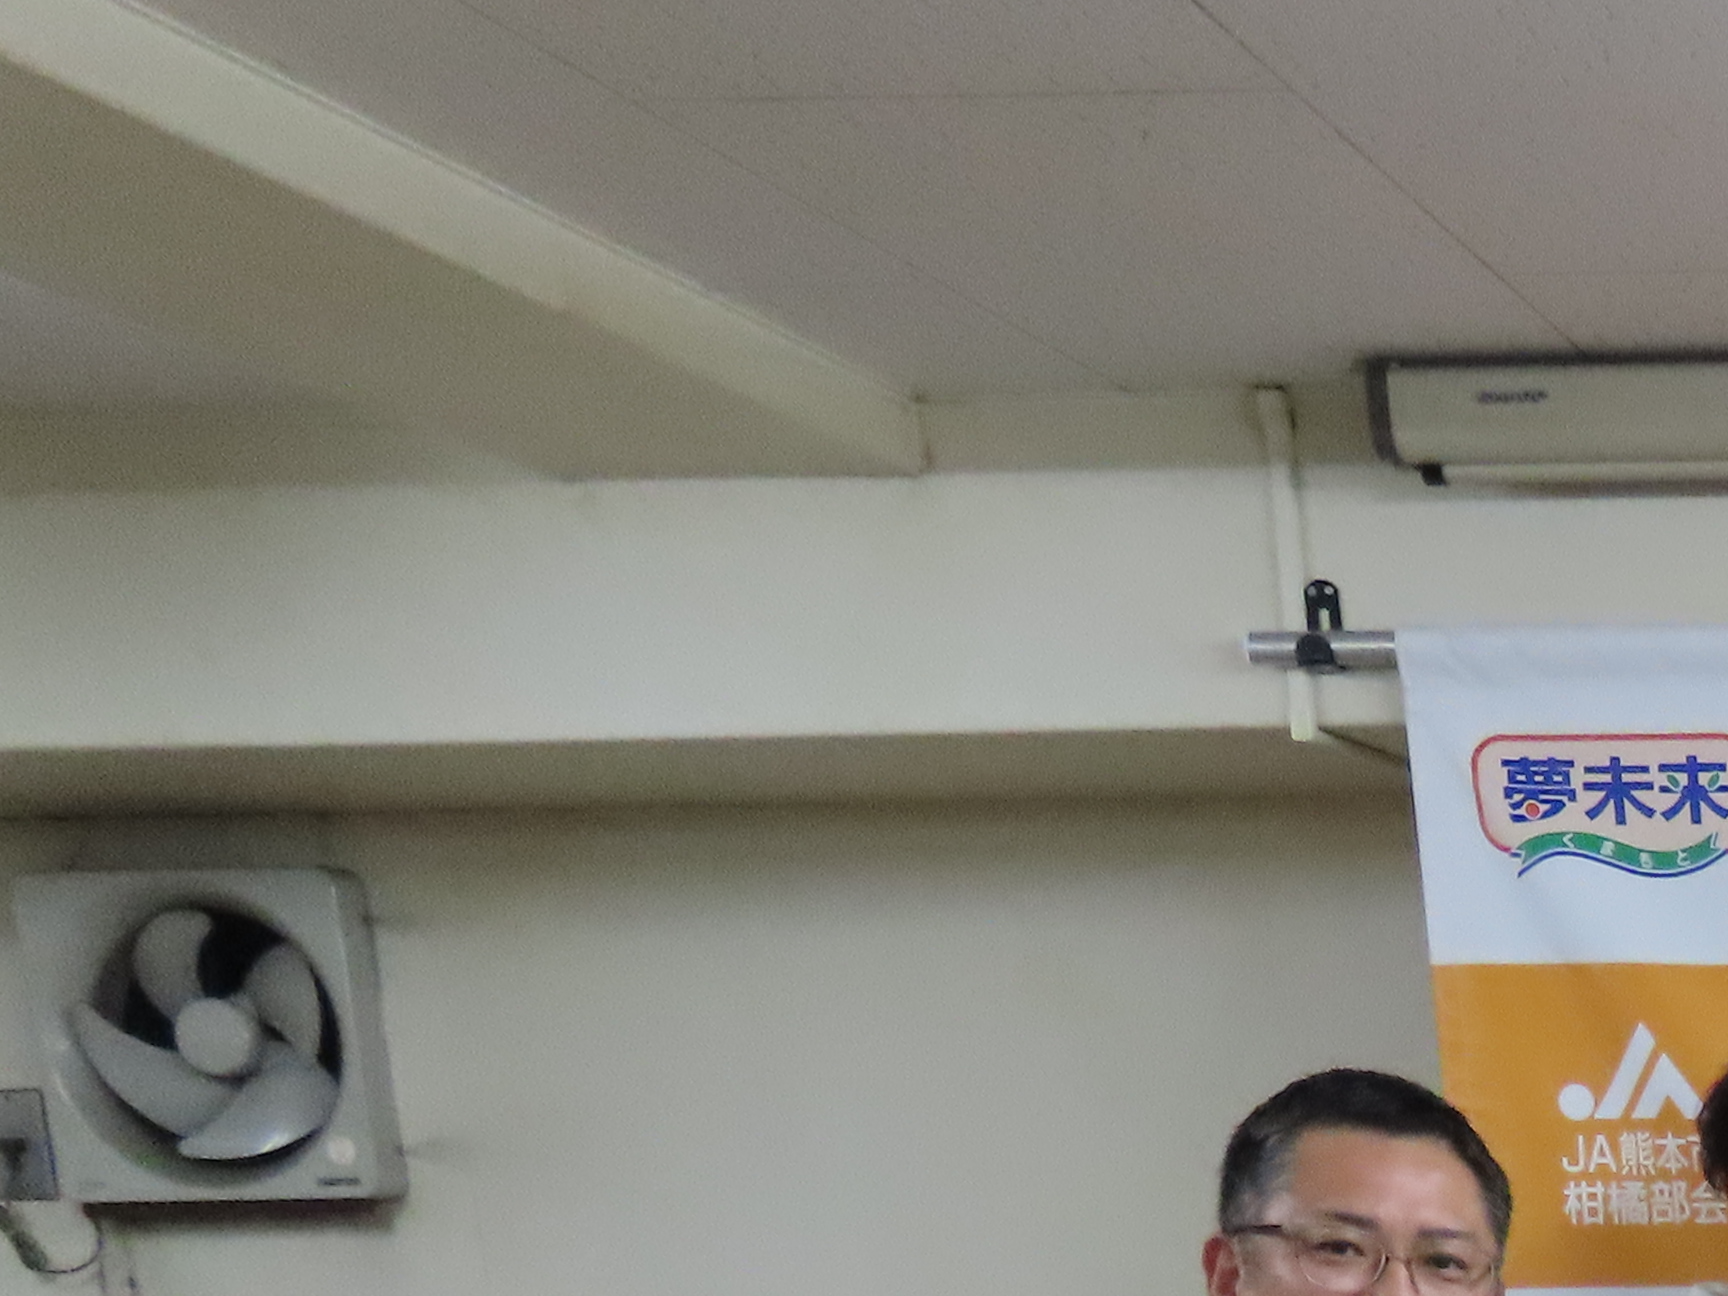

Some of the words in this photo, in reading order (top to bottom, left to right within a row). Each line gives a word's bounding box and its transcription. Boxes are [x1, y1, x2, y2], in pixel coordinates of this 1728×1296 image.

[1562, 833, 1691, 868] くまもと
[1563, 1180, 1728, 1225] 柑橘部会
